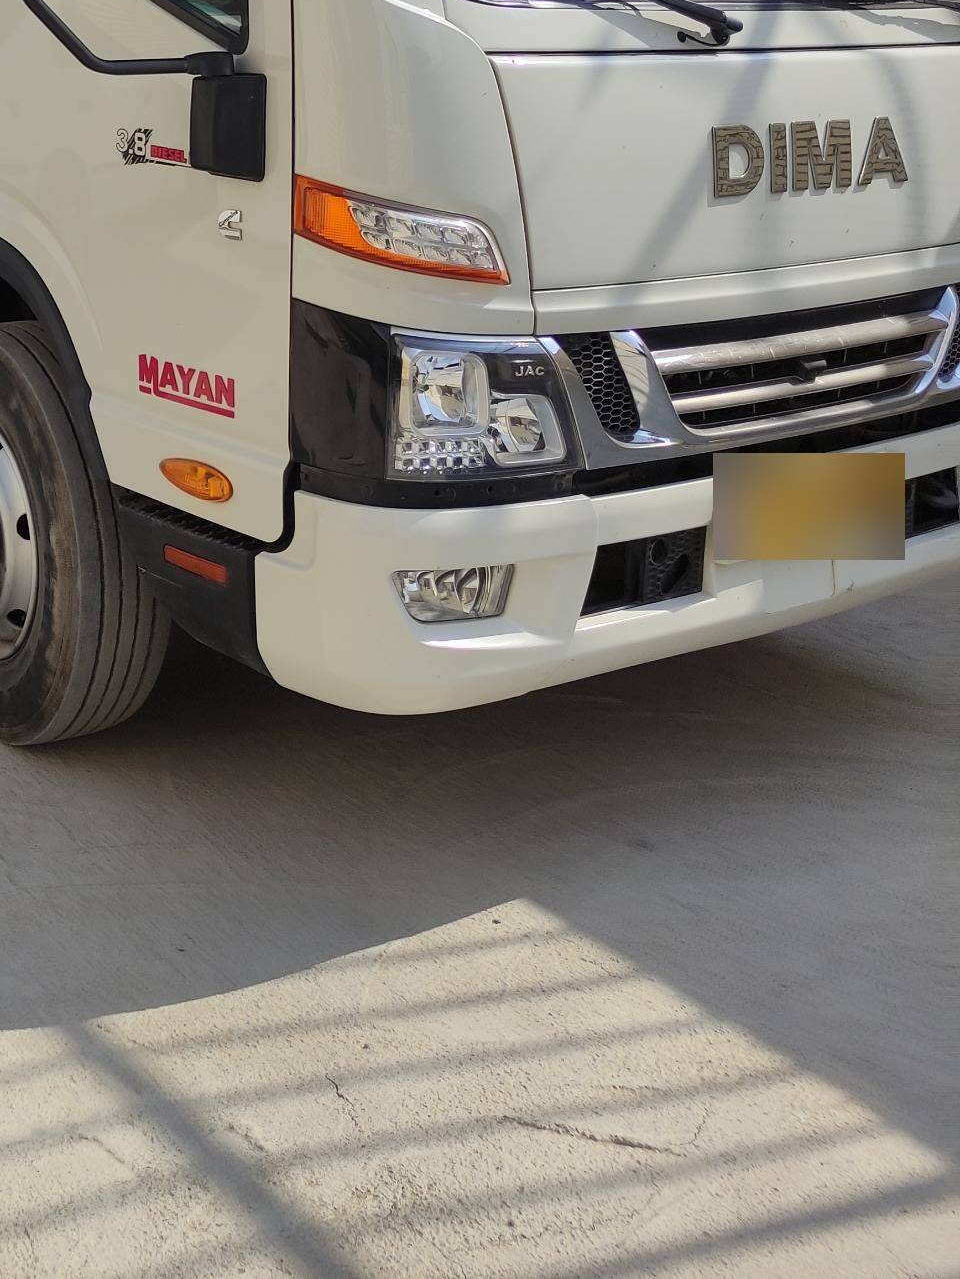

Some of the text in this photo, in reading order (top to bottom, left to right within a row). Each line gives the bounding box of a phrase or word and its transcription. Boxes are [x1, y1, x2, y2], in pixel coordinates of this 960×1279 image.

[116, 128, 188, 164] 3.8 DIESEL
[711, 116, 909, 199] DIMA
[138, 353, 235, 415] MAYAN
[514, 365, 545, 377] JAC
